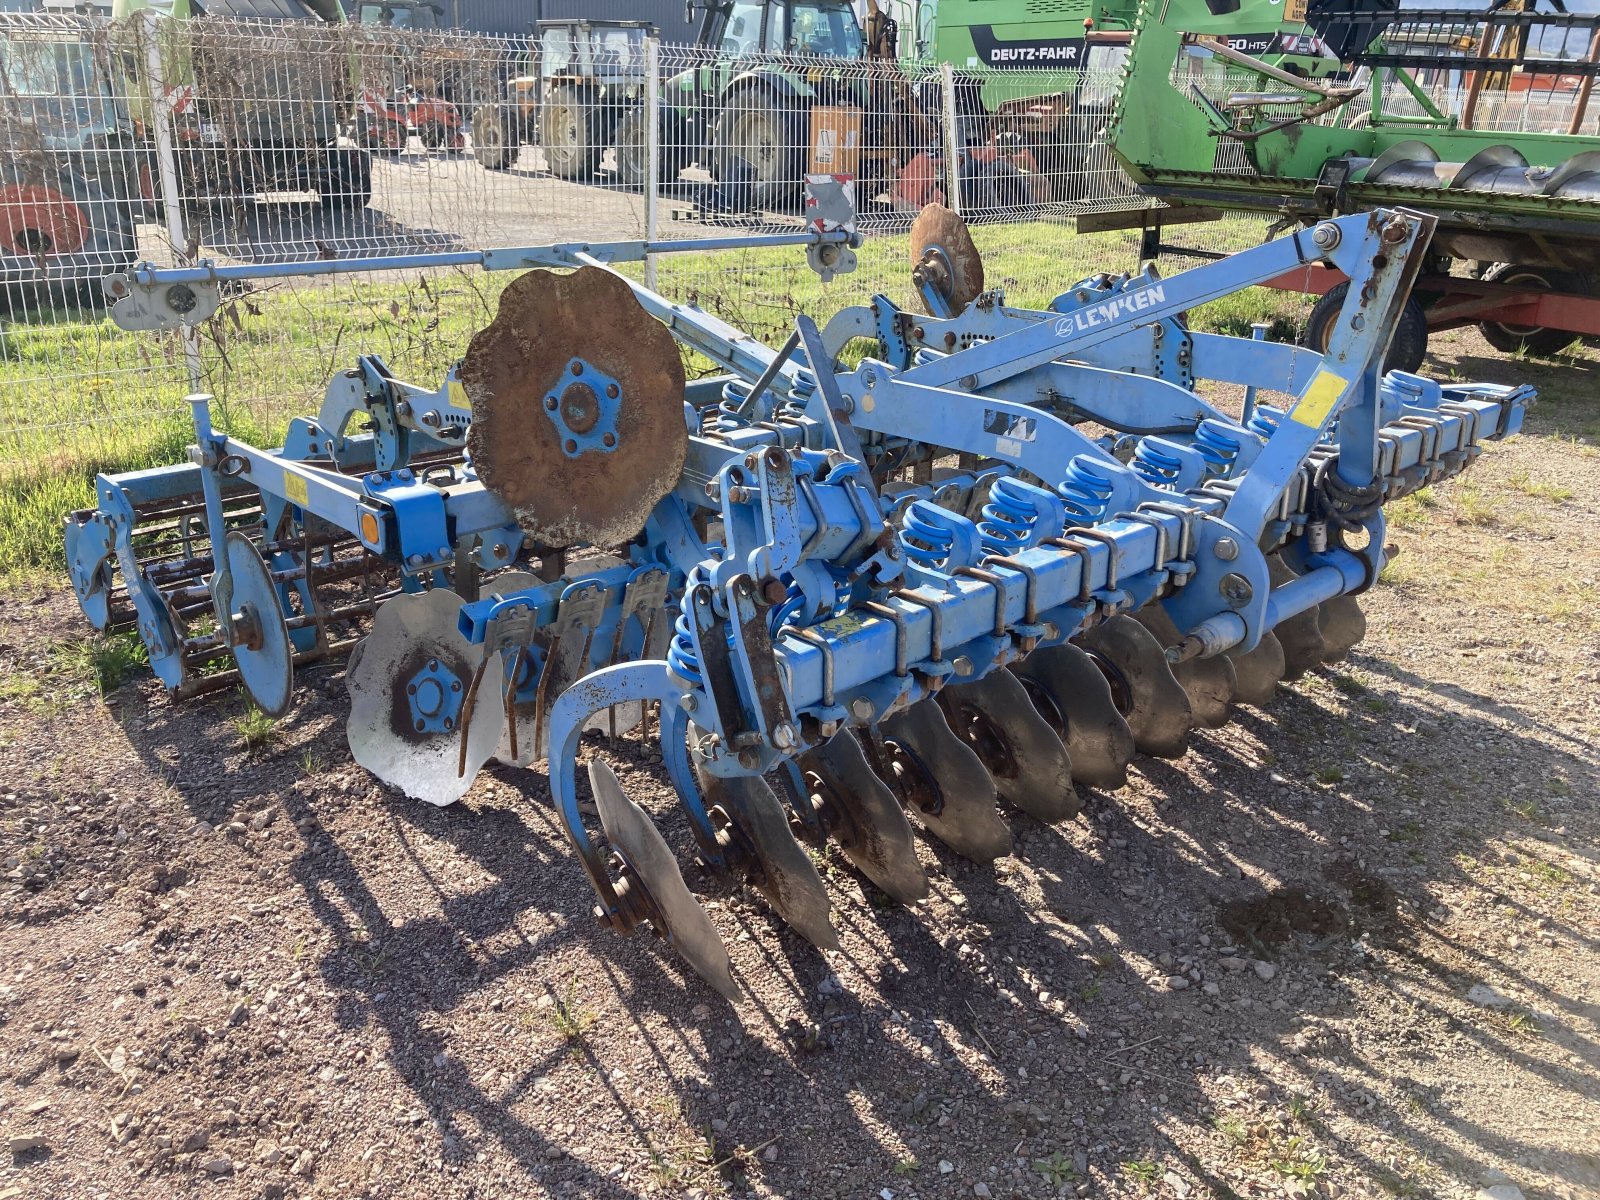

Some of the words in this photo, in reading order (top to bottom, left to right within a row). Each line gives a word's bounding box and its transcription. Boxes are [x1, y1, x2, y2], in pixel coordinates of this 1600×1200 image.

[1248, 41, 1268, 50] HTS
[991, 47, 1077, 60] DEUTZ-FAHR
[1074, 285, 1166, 331] LEMKEN
